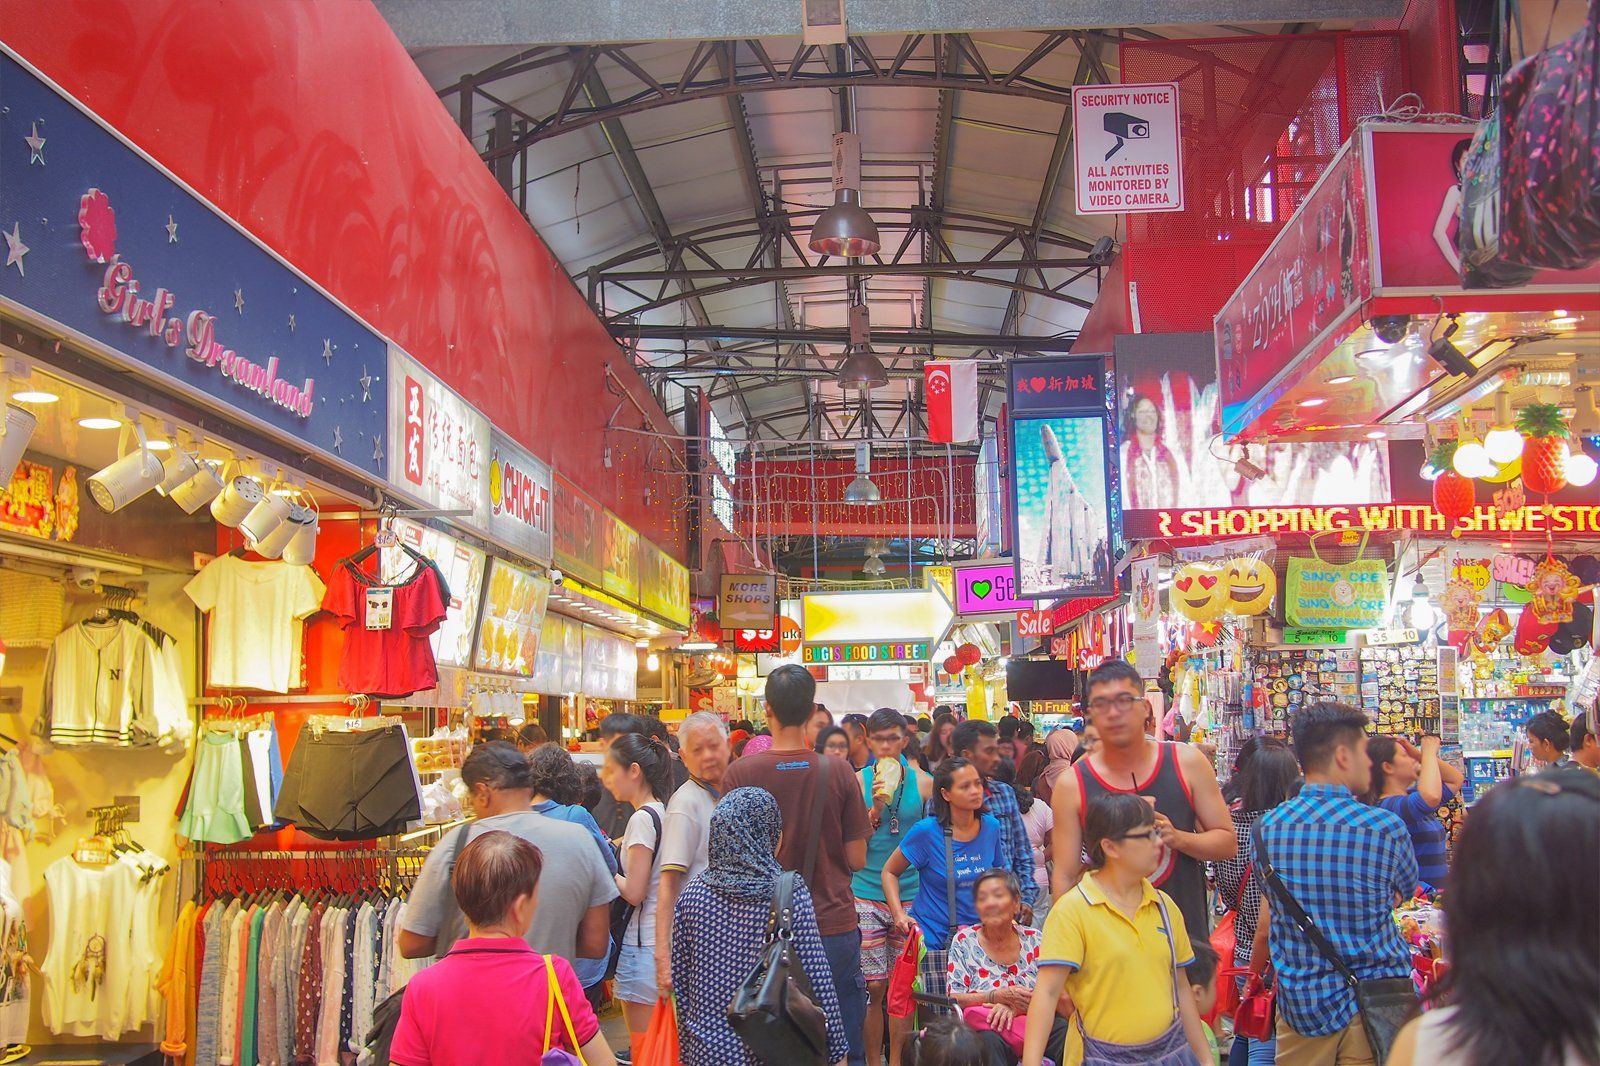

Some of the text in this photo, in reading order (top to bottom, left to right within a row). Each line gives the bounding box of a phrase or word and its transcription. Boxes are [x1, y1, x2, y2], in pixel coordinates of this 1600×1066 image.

[1082, 93, 1170, 107] SECURITY NOTICE
[1087, 164, 1169, 177] ALL ACTIVITIES
[1088, 178, 1169, 192] MONITORED BY
[1089, 193, 1169, 206] VIDEO CAMERA
[186, 310, 314, 418] Dreamland
[1017, 375, 1097, 393] 我 新加坡
[504, 462, 549, 534] CHICK-IT
[1181, 507, 1350, 535] SHOPPING
[1493, 556, 1534, 585] SALE!
[729, 582, 768, 592] MORE
[726, 594, 770, 605] SHOPS
[1019, 611, 1050, 636] Sale
[806, 646, 841, 662] BUGIS
[845, 645, 877, 661] FOOD
[881, 643, 928, 660] STREET
[1080, 649, 1104, 669] Sale
[109, 668, 121, 680] N
[1045, 701, 1070, 713] Fruit
